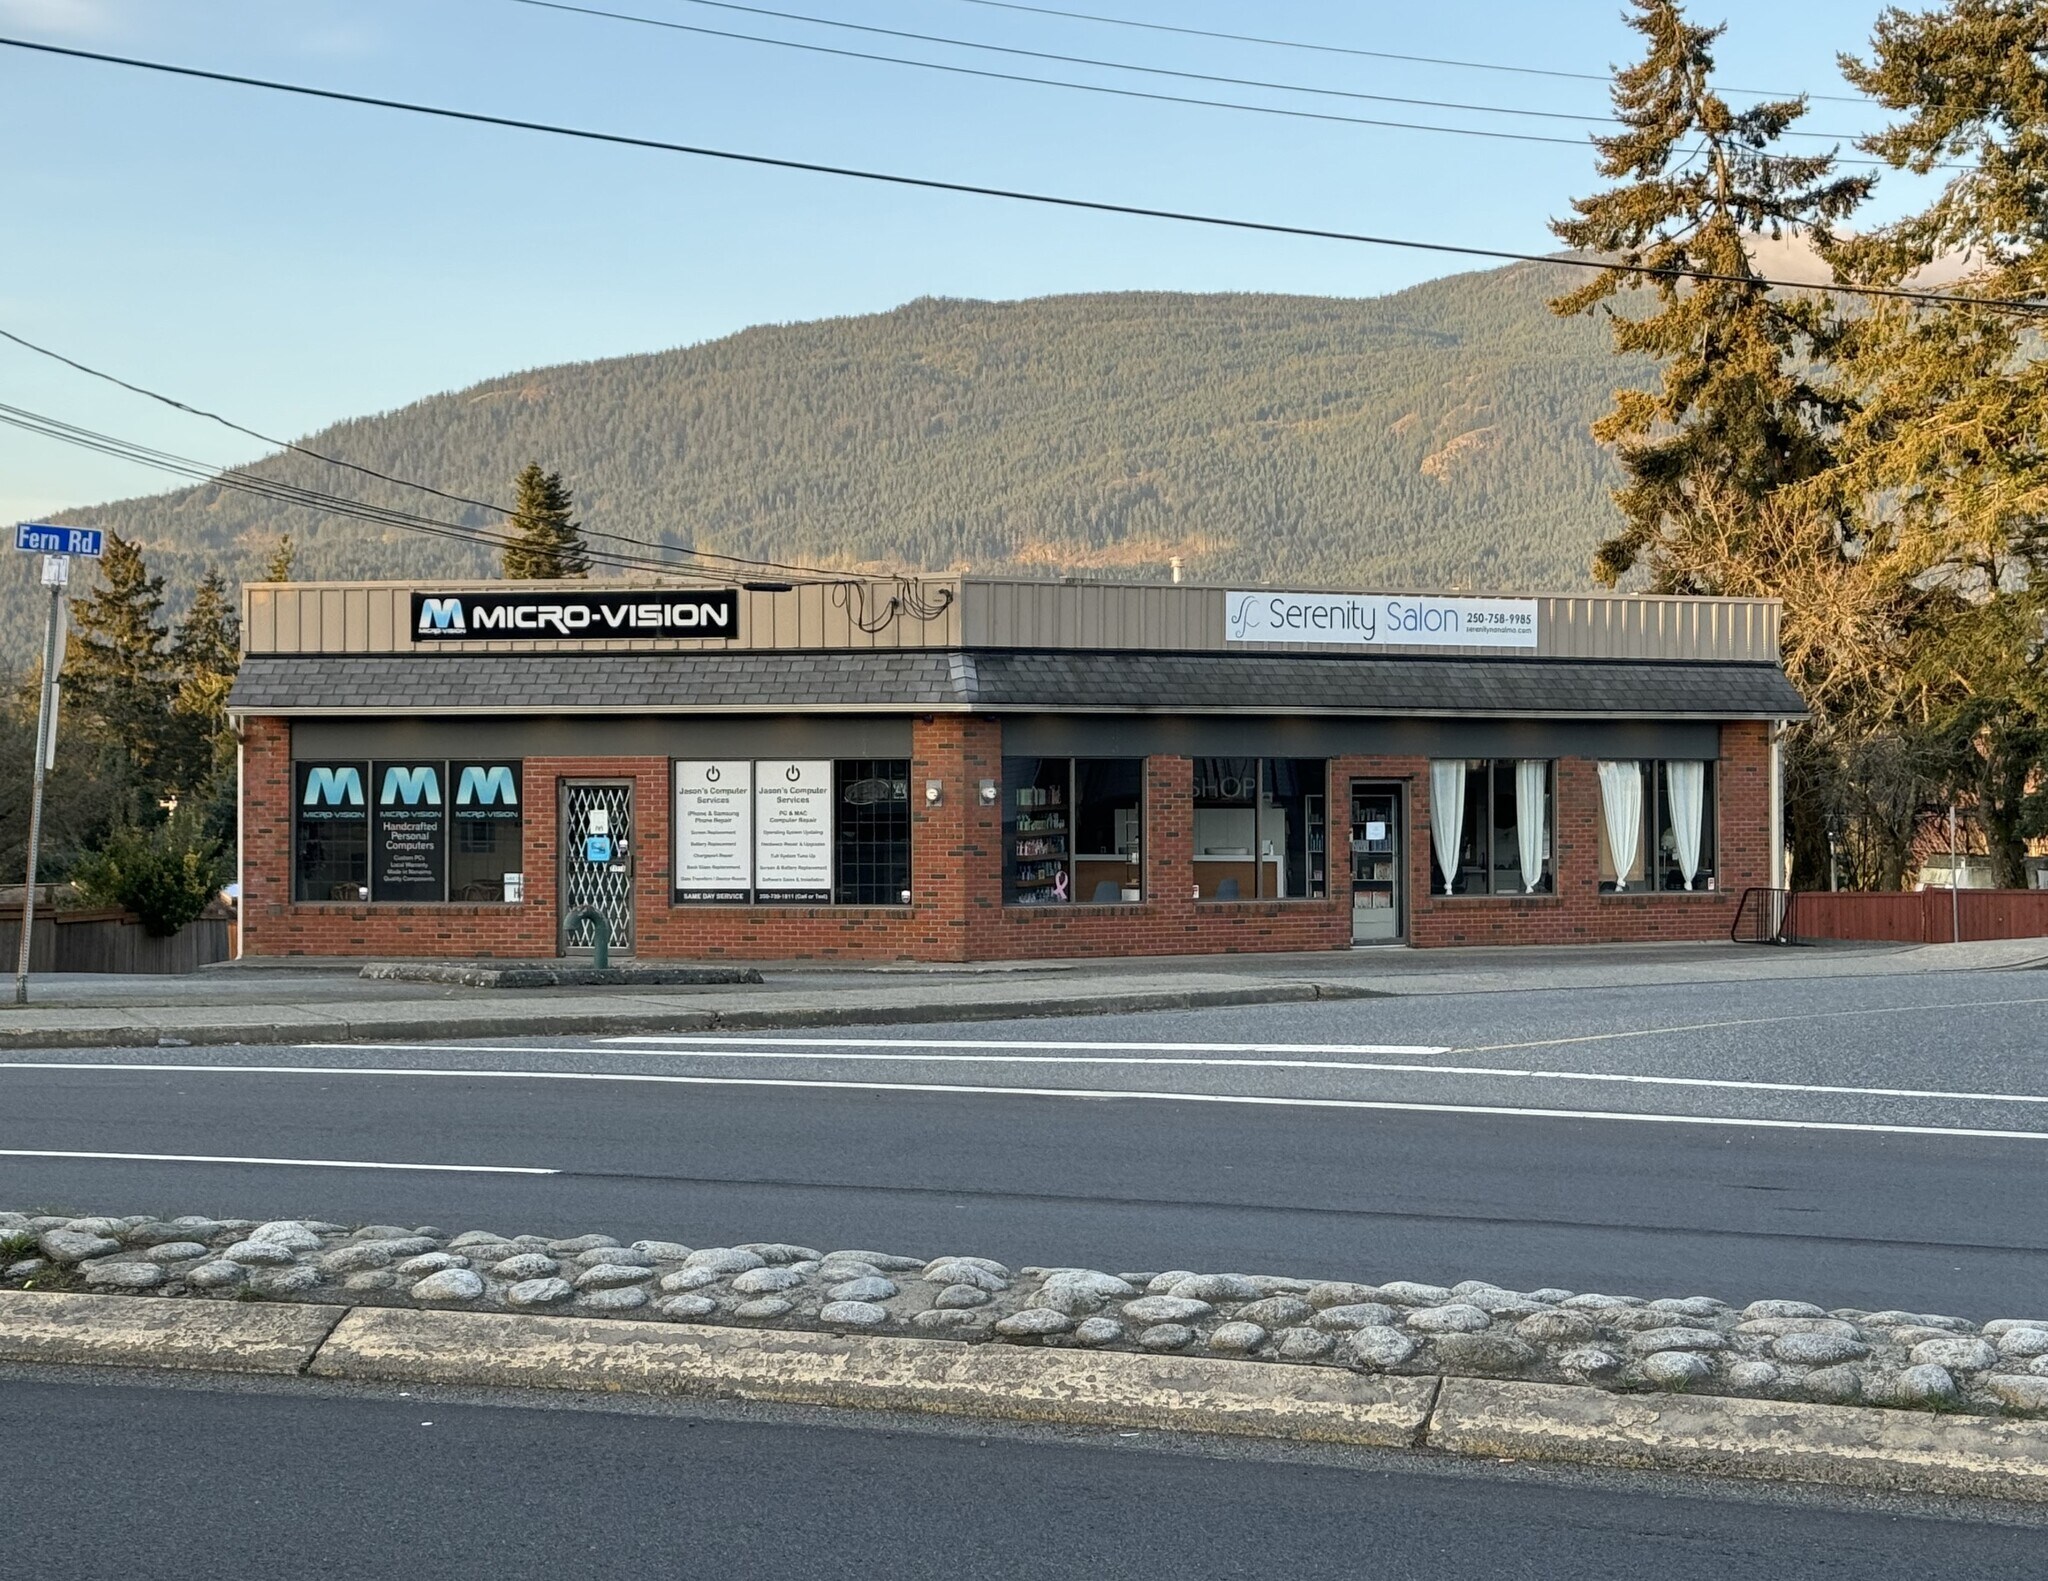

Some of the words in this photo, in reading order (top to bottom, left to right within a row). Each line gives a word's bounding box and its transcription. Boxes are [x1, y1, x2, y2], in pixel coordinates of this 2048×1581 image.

[18, 526, 60, 550] Fern
[68, 530, 99, 554] Rd.
[472, 603, 728, 634] MICRO-VISION
[1269, 598, 1377, 641] Serenity
[1386, 601, 1459, 632] Salon
[1466, 612, 1532, 625] 250-758-9985
[679, 787, 709, 795] Jason's
[709, 787, 748, 796] Computer
[758, 786, 789, 795] Jason's
[789, 786, 828, 795] Computer
[696, 796, 730, 804] Services
[776, 796, 810, 804] Services
[383, 821, 438, 831] Handcrafted
[391, 831, 430, 840] Personal
[385, 840, 435, 851] Computers
